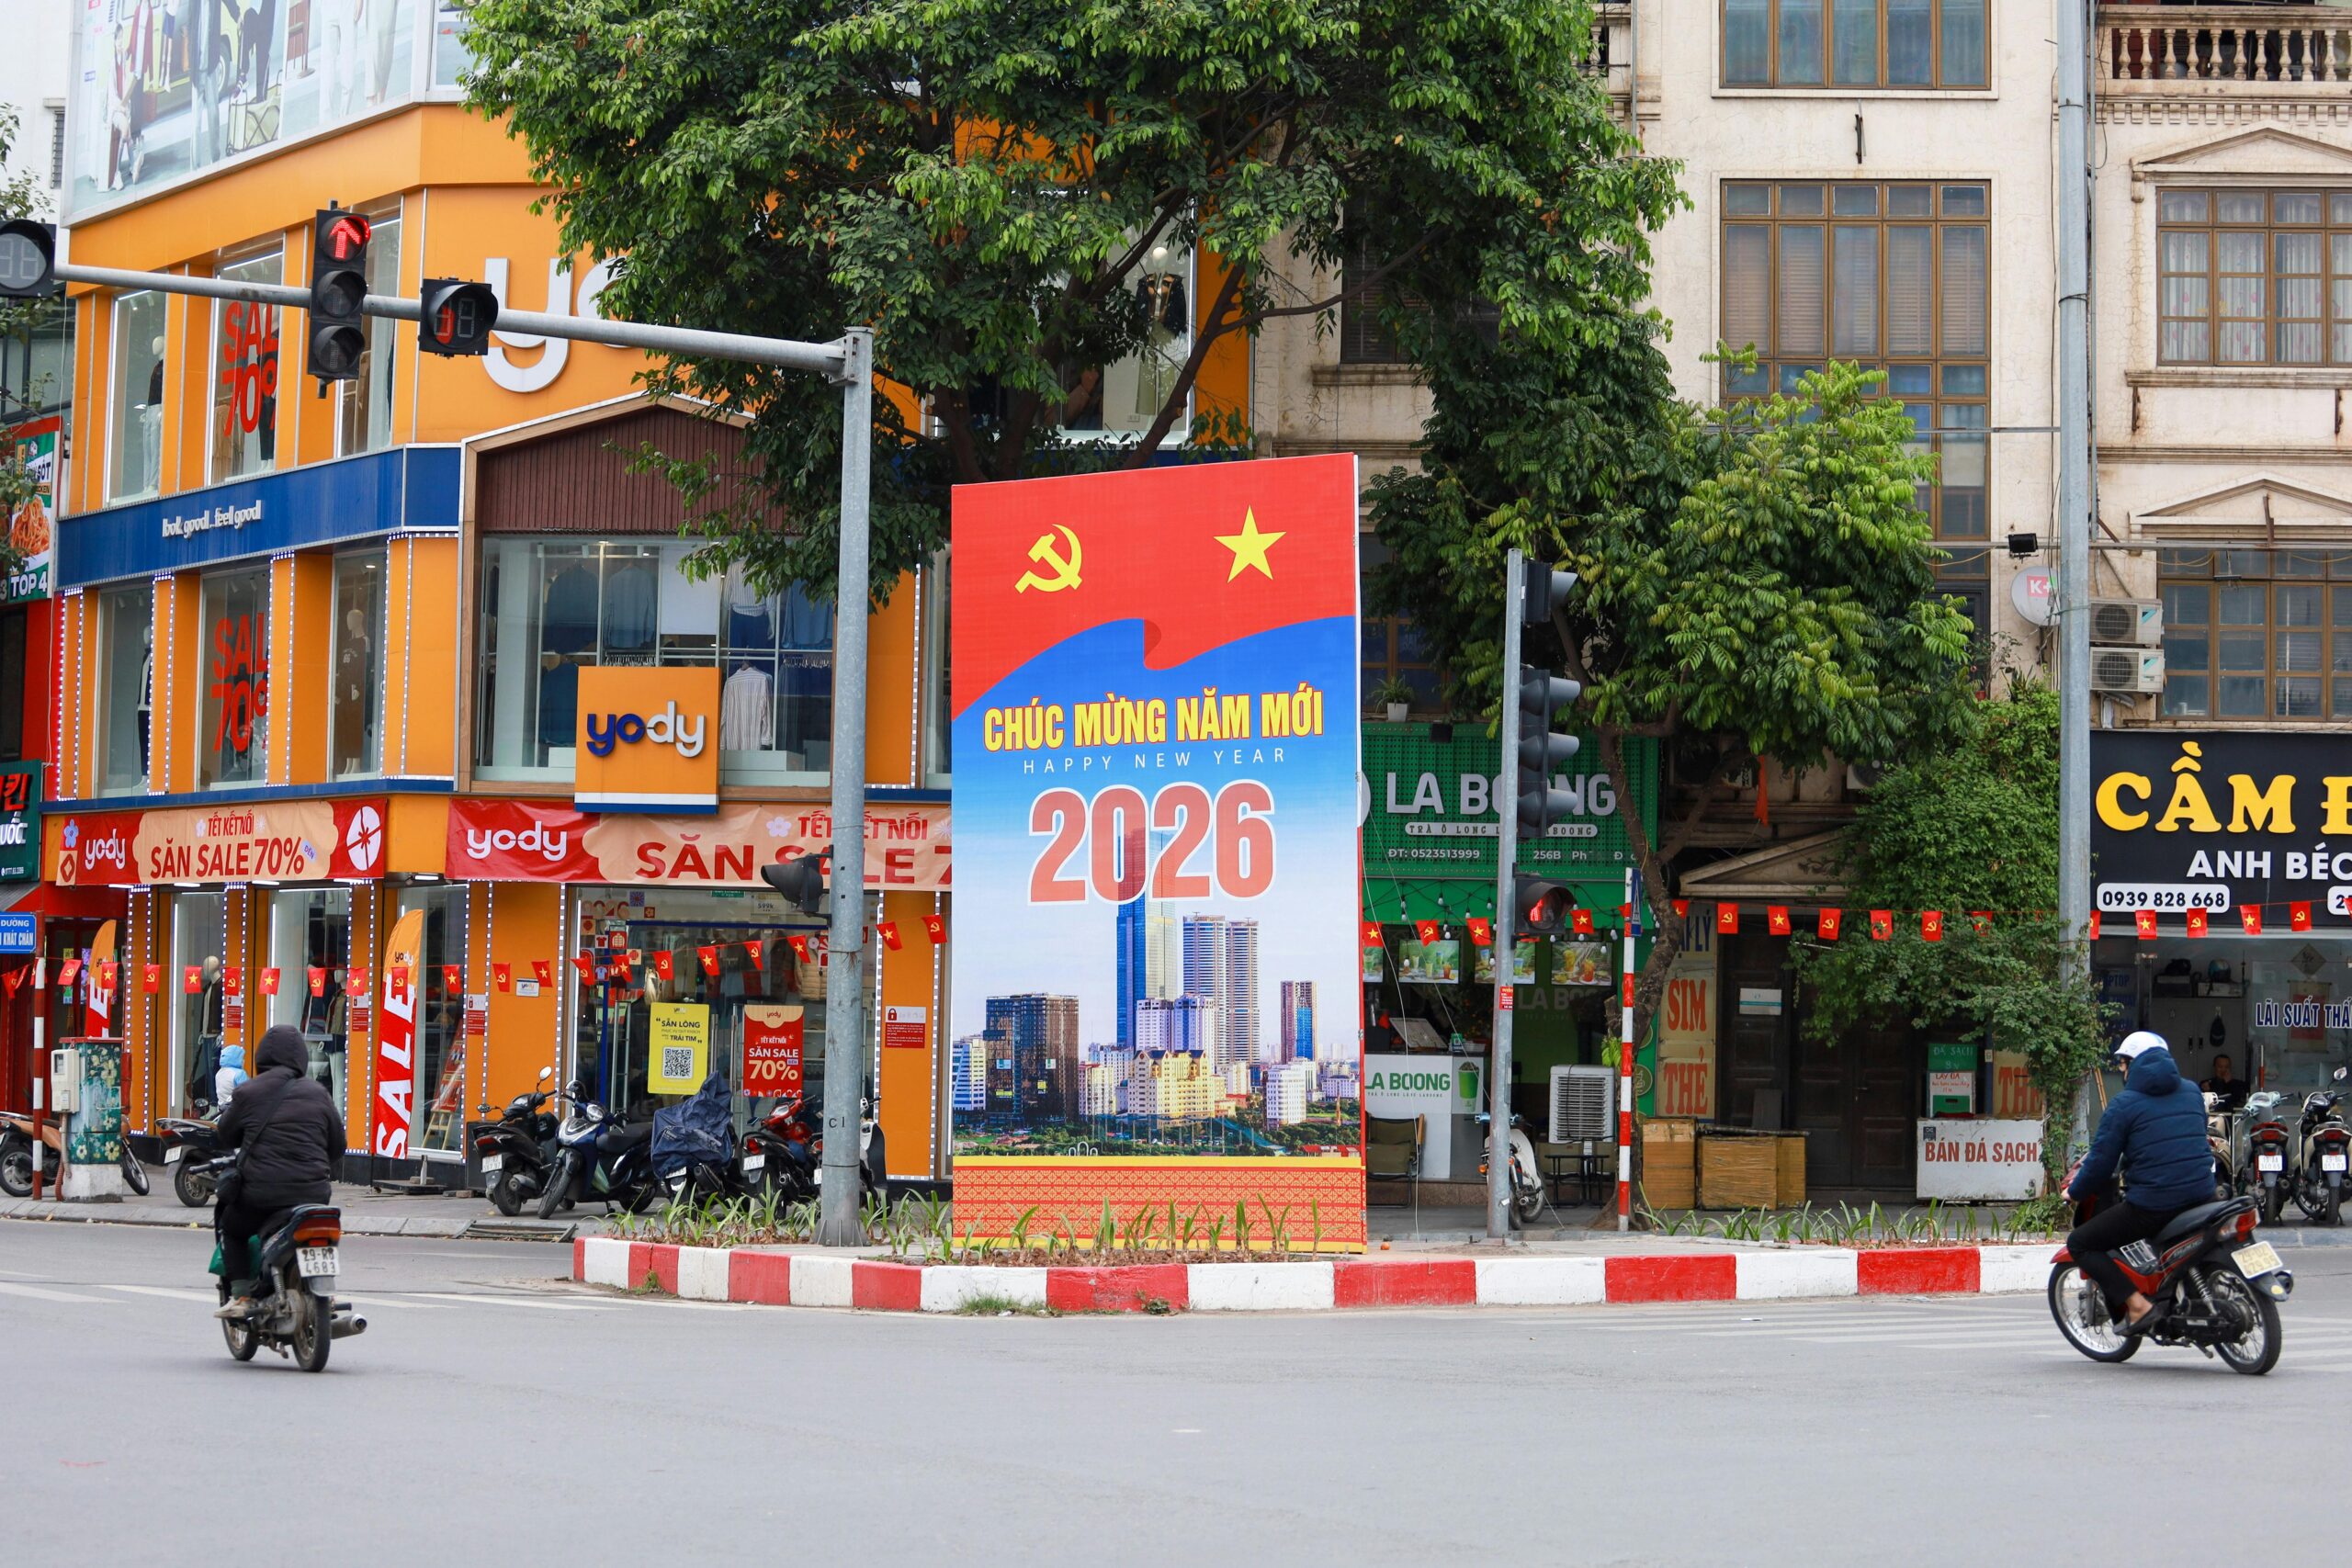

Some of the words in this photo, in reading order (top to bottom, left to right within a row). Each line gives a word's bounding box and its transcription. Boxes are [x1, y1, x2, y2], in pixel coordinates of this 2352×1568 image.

[233, 499, 262, 529] good
[10, 572, 37, 597] TOP
[38, 570, 47, 592] 4
[586, 700, 707, 758] yody
[983, 696, 1066, 752] CHÚC
[1073, 692, 1168, 748] MỪNG
[1175, 686, 1251, 742] NĂM
[1260, 681, 1325, 739] MỚI
[1023, 755, 1113, 774] HAPPY
[1135, 751, 1192, 770] NEW
[1214, 748, 1285, 766] YEAR
[1386, 772, 1444, 815] LA
[2096, 741, 2297, 833] CẦM
[208, 812, 221, 838] TẾT
[1408, 822, 1432, 835] TRÀ
[1456, 825, 1487, 835] LONG
[85, 829, 126, 870] yody
[466, 821, 568, 862] yody
[1027, 778, 1276, 906] 2026
[1410, 849, 1480, 860] 0523513999
[1533, 850, 1562, 861] 256B
[151, 838, 190, 879] SĂN
[196, 841, 250, 878] SALE
[254, 837, 304, 876] 70%
[635, 833, 754, 881] SĂN
[2186, 850, 2271, 879] ANH
[2102, 891, 2148, 907] 0939
[2154, 892, 2187, 908] 828
[2191, 892, 2225, 908] 668
[395, 951, 413, 966] yody
[1668, 978, 1707, 1032] SIM
[2256, 998, 2279, 1027] LÃI
[2283, 995, 2320, 1028] SUẤT
[2324, 996, 2352, 1029] THẤ
[376, 973, 415, 1160] SALE
[749, 1045, 771, 1057] SĂN
[773, 1048, 799, 1058] SALE
[748, 1059, 798, 1080] 70%
[1389, 1072, 1451, 1091] BOONG
[1663, 1045, 1709, 1115] THẺ
[1925, 1137, 1960, 1162] BÁN
[1965, 1137, 1987, 1163] ĐÁ
[1992, 1142, 2037, 1167] SẠCH
